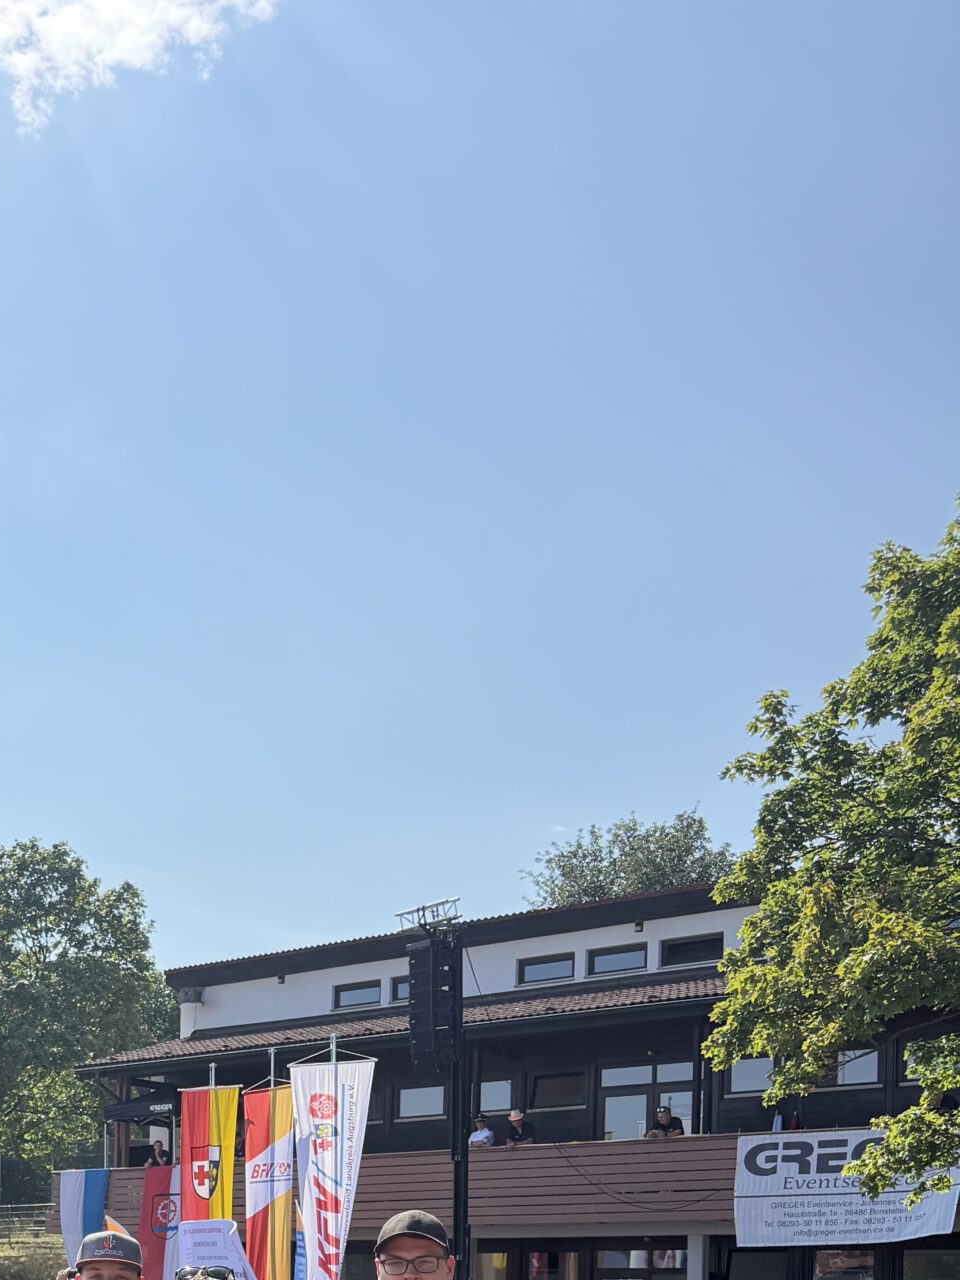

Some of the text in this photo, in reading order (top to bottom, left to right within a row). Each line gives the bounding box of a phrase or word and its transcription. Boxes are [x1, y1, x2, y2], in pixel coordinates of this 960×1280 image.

[347, 1101, 355, 1144] Augsburg
[346, 1144, 354, 1188] Landkreis
[771, 1201, 806, 1210] GREGER
[807, 1200, 854, 1208] Eventservice
[783, 1209, 828, 1219] Hauptstraße
[830, 1209, 838, 1217] 1a
[844, 1208, 869, 1216] 86486
[803, 1219, 813, 1227] 50
[863, 1217, 886, 1225] 08293
[793, 1225, 895, 1238] info@greger-eventservicede
